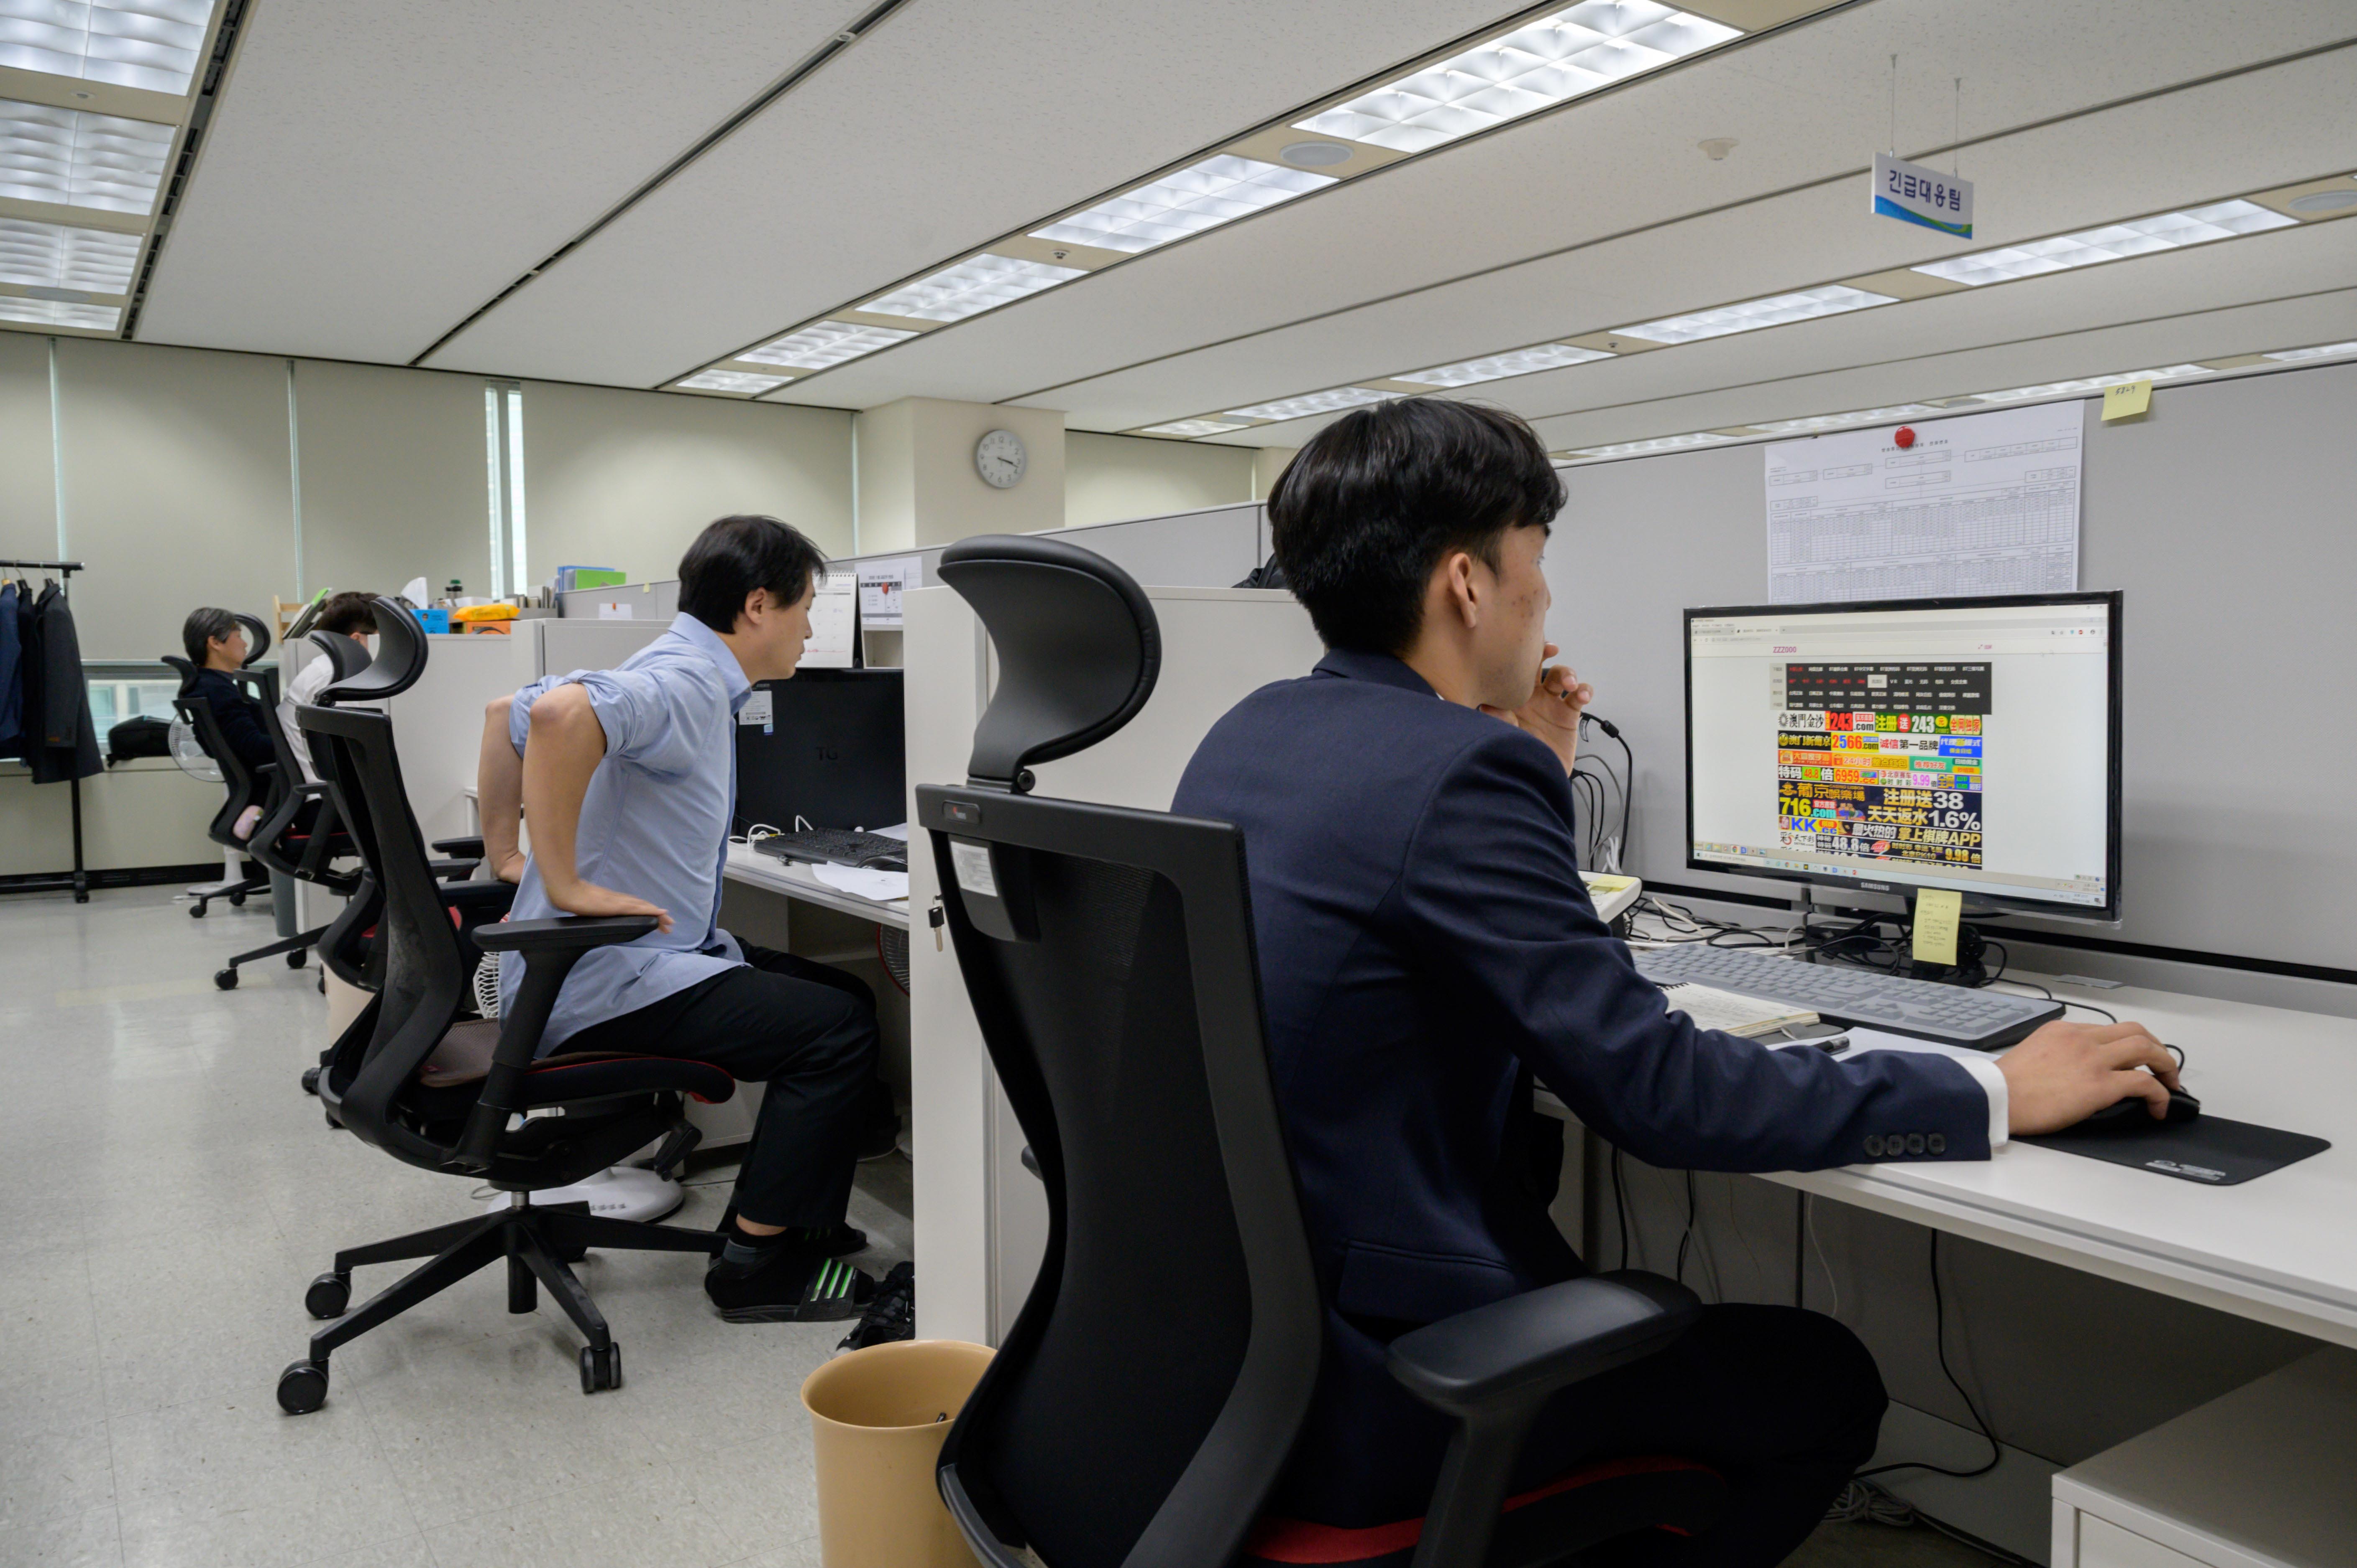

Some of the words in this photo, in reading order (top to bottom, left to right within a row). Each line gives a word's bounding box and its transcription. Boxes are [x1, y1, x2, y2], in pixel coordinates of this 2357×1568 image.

[1889, 169, 1960, 212] 긴급대응팀
[1789, 713, 1824, 729] 澳門金沙
[1880, 739, 1938, 751] 诚信第一品牌
[1852, 823, 1897, 839] 最火热的
[1897, 826, 1981, 847] 掌上棋牌APP
[1861, 882, 1890, 891] SAMSUNG
